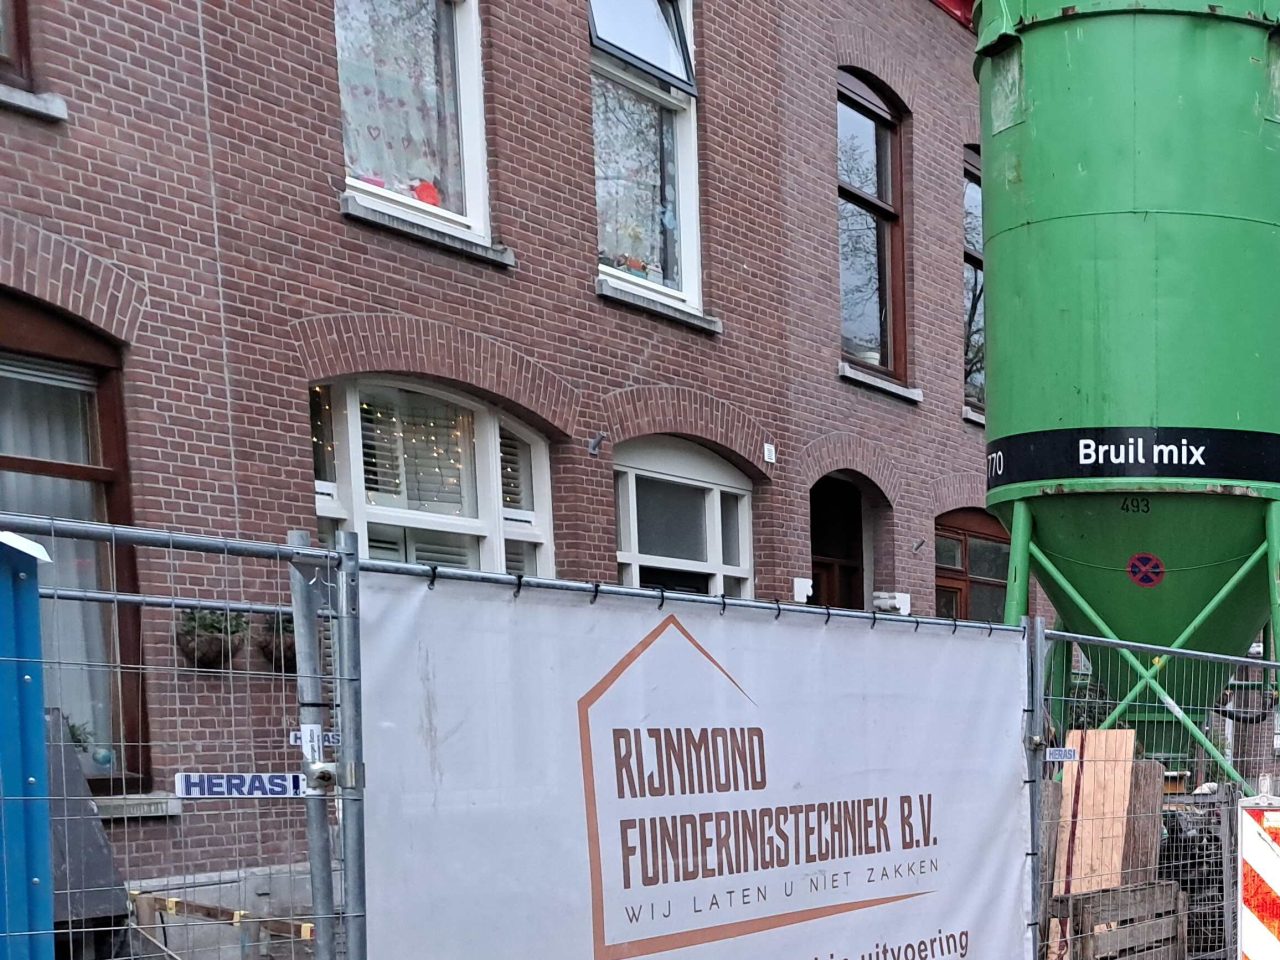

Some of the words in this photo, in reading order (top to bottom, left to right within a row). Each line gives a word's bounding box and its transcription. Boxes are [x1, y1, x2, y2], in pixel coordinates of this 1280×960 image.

[1078, 438, 1146, 465] Bruil
[1152, 439, 1206, 466] mix
[1120, 498, 1151, 514] 493
[294, 733, 341, 744] HAS
[612, 726, 768, 800] RIJNMOND
[619, 796, 892, 889] FUNDERINGSTECHNIEK
[900, 794, 938, 852] B.V.
[625, 902, 673, 925] WIJ
[693, 883, 769, 914] LATEN
[784, 877, 794, 898] U
[809, 870, 852, 893] NIET
[867, 858, 941, 884] ZAKKEN
